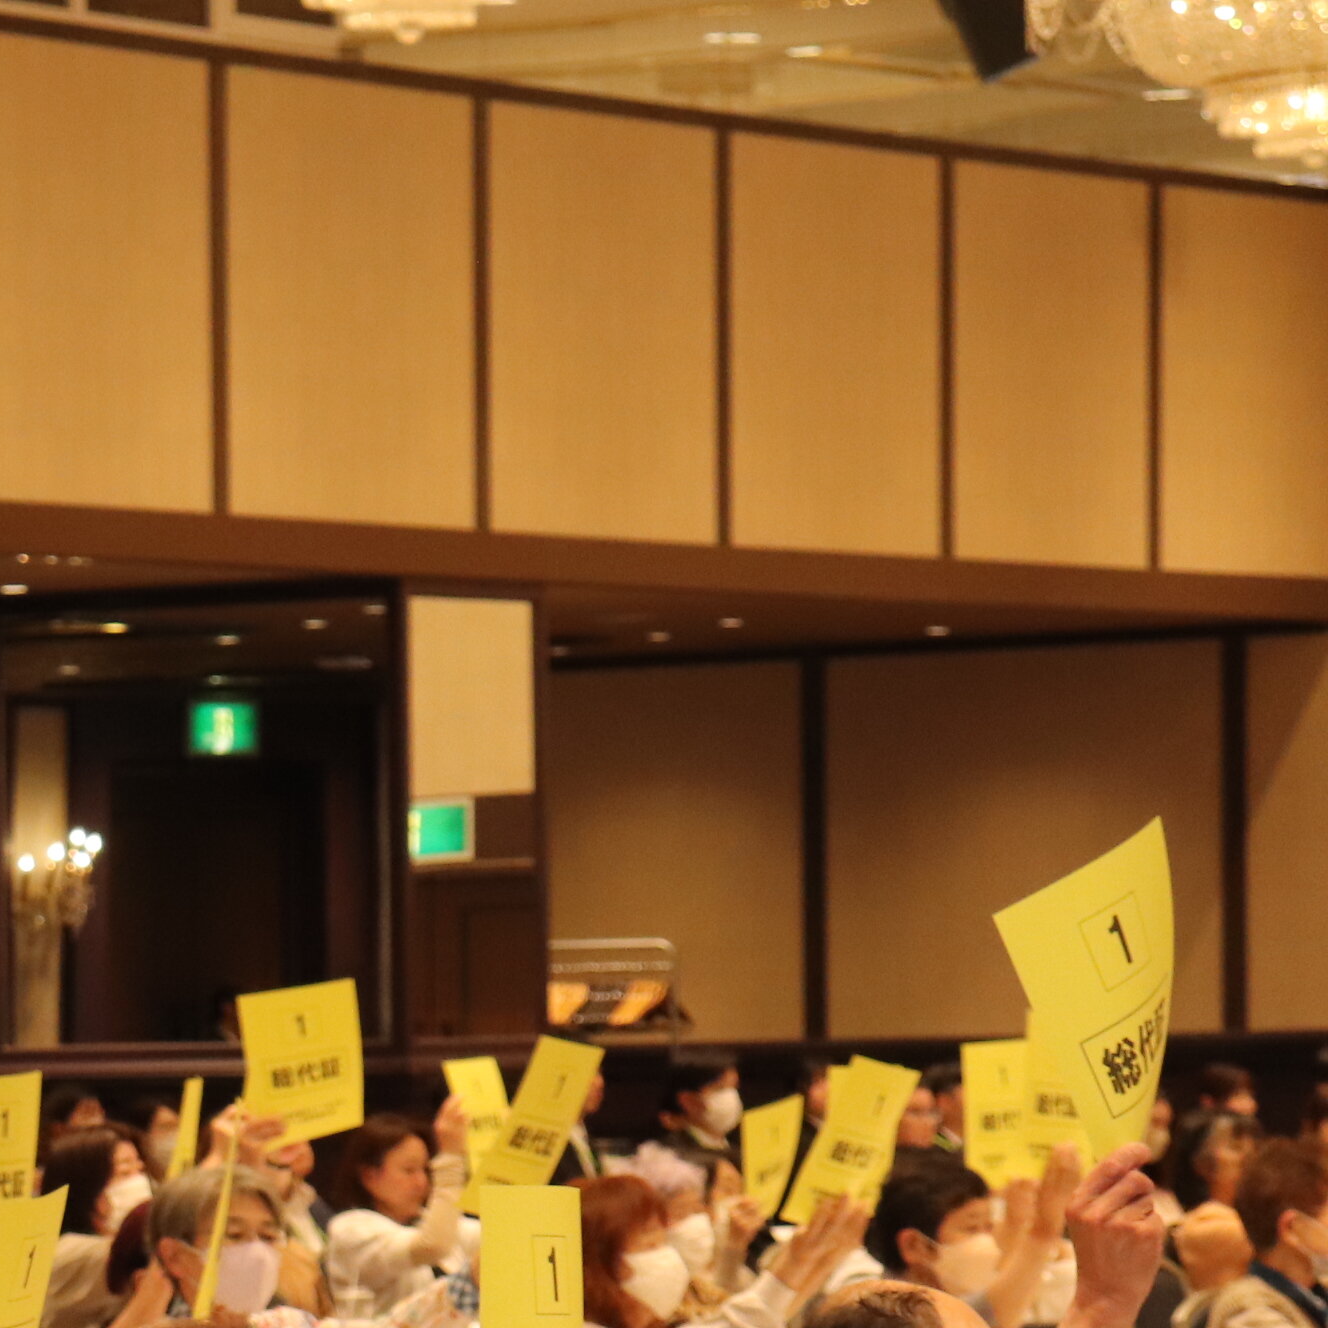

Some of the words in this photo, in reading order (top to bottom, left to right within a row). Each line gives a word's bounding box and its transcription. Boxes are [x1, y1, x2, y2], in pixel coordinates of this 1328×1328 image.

[1108, 914, 1133, 964] 1
[296, 1013, 307, 1037] 1
[1, 1107, 10, 1138] 1
[24, 1243, 37, 1289] 1
[547, 1246, 559, 1302] 1
